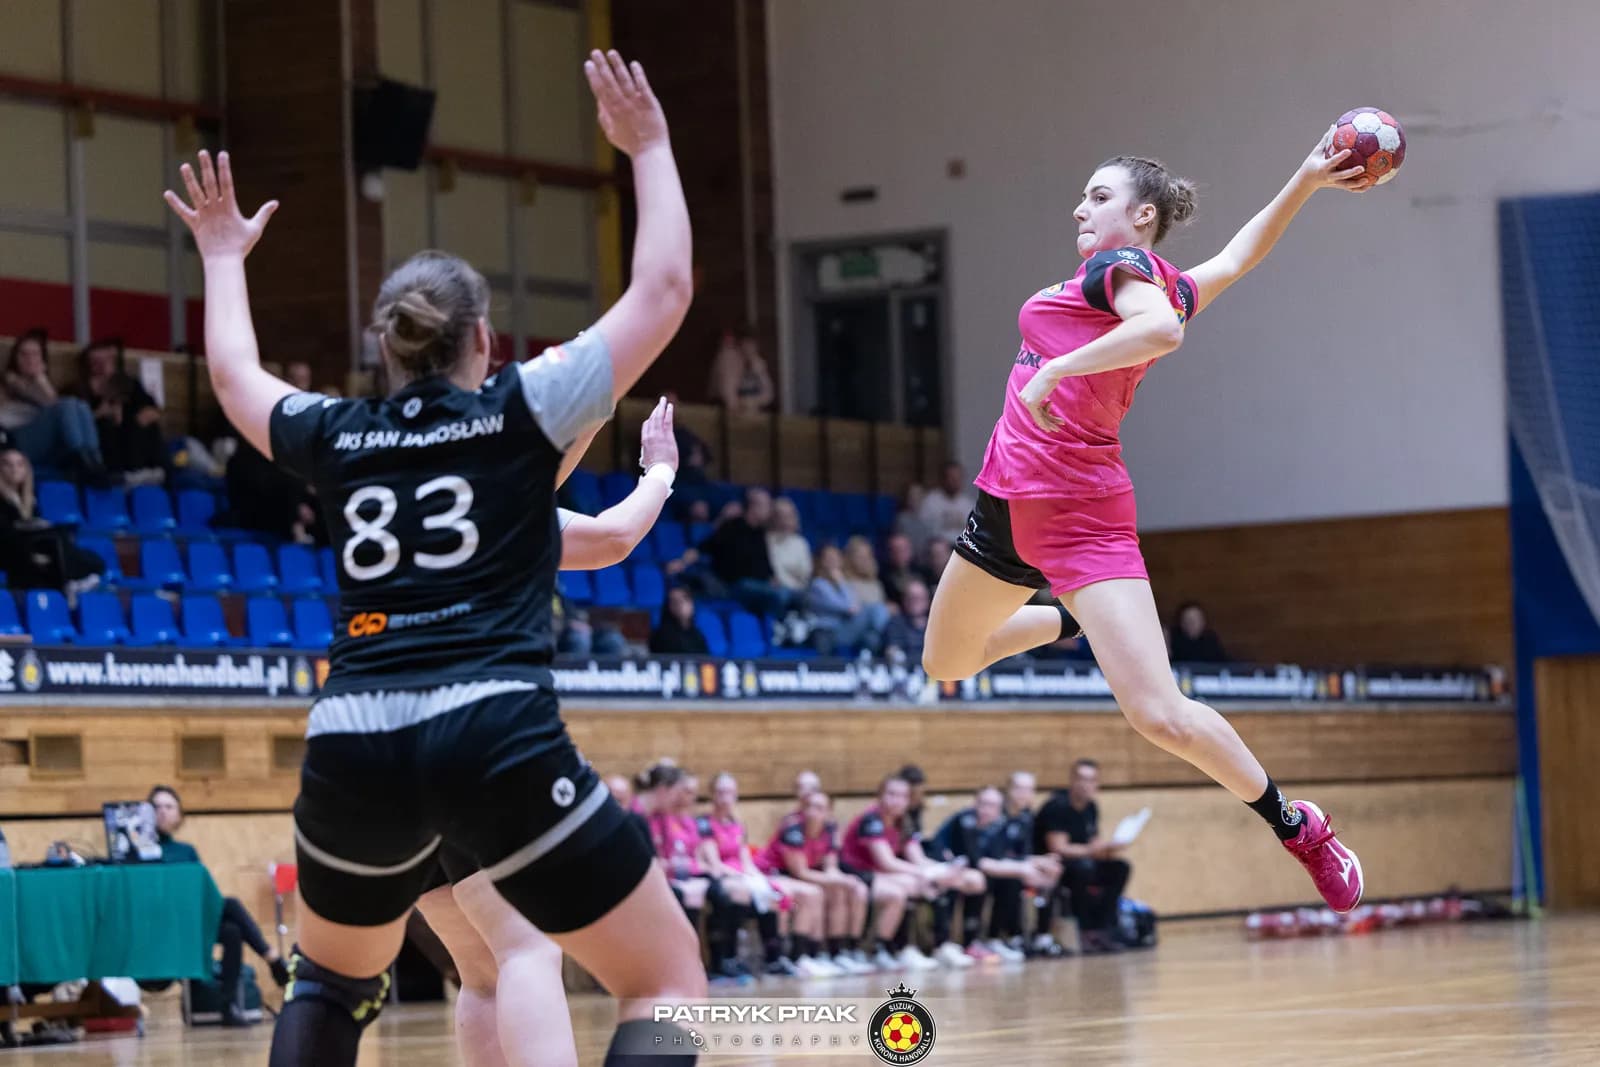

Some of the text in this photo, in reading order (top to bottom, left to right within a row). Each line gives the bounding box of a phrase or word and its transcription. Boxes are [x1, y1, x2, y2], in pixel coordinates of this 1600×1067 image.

[334, 414, 504, 450] JKS SAN JAROSŁAW
[343, 475, 480, 581] 83
[47, 651, 288, 696] www.koronahandball.pl
